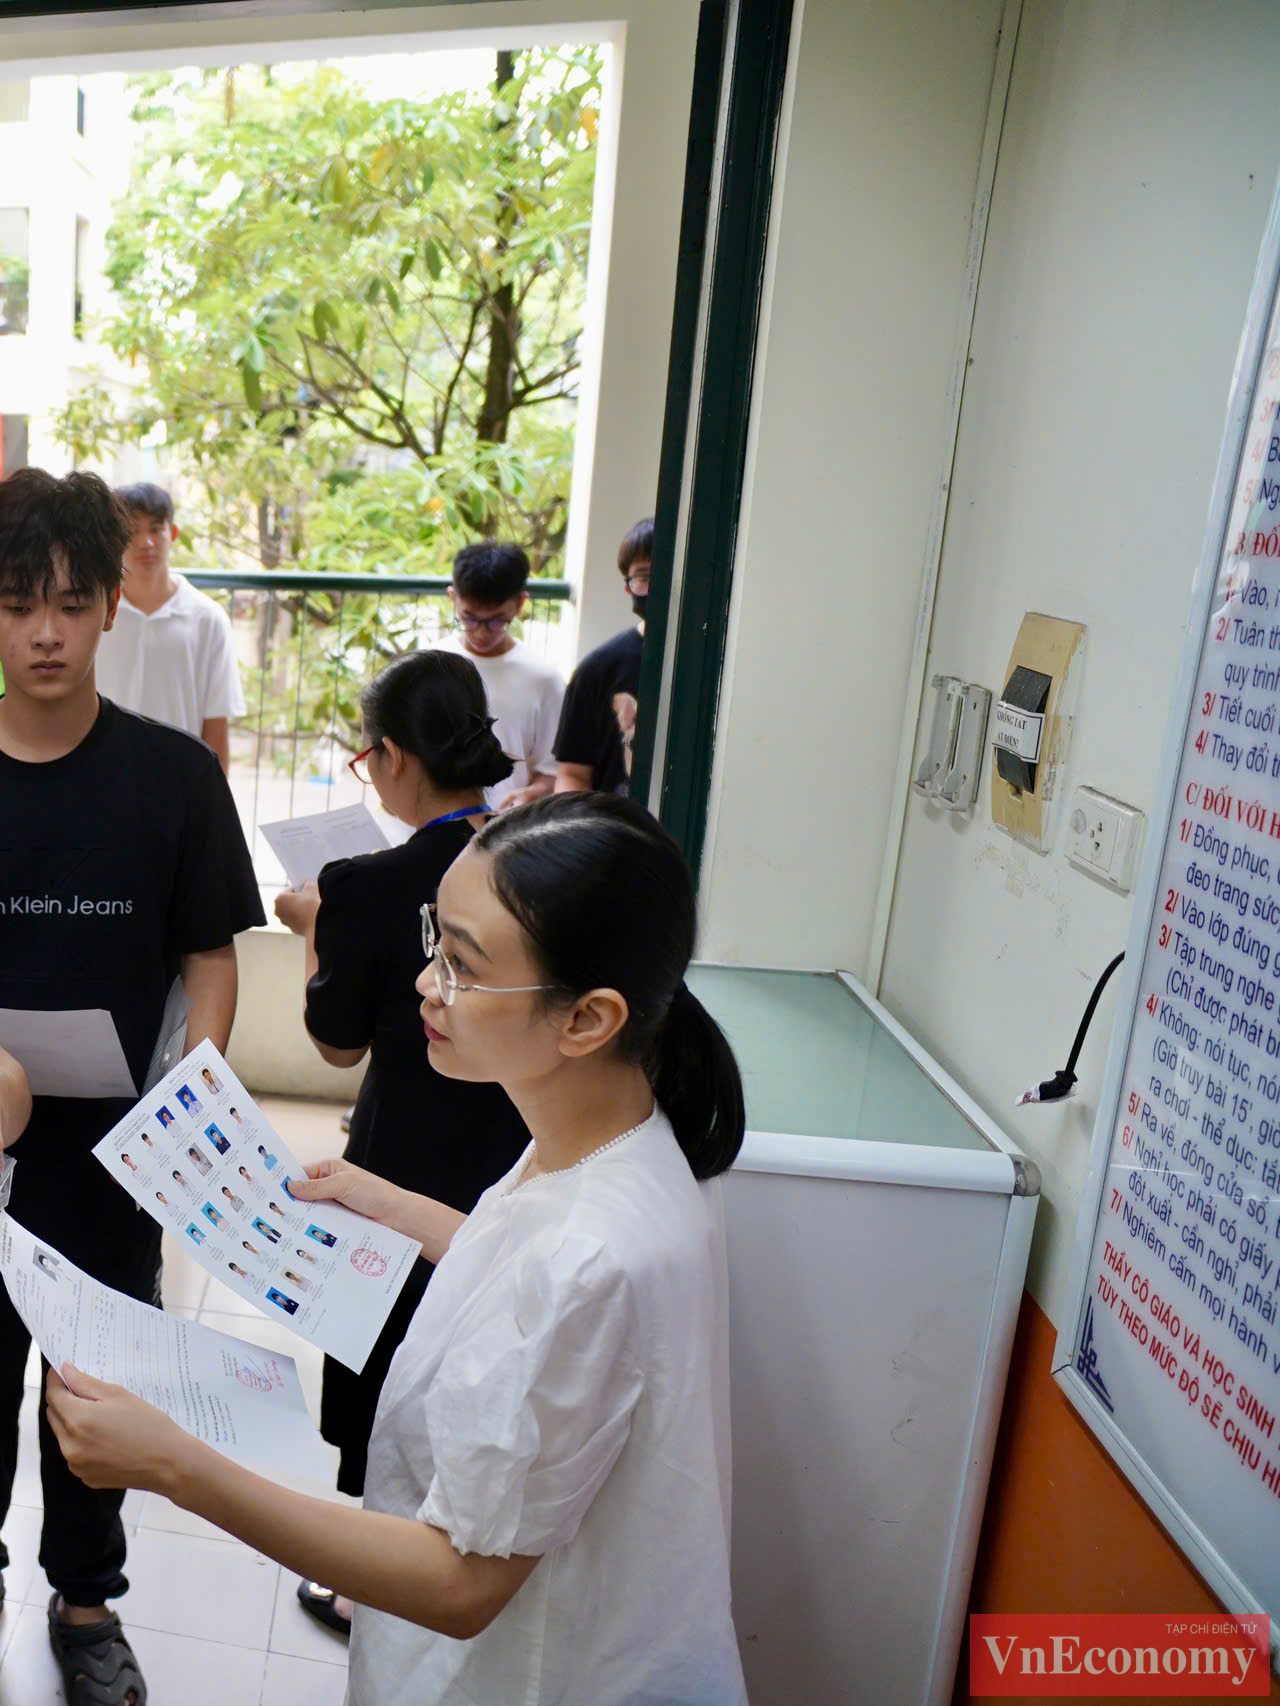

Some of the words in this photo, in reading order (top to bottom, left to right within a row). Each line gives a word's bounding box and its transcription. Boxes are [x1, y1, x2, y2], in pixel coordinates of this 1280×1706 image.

[1216, 617, 1231, 641] 2/
[1233, 618, 1265, 647] Tuân
[1241, 579, 1269, 610] Vào,
[1202, 691, 1217, 717] 3/
[1219, 695, 1242, 724] Tiết
[1245, 703, 1276, 733] cuối
[1224, 663, 1250, 691] quy
[1194, 729, 1209, 755] 4/
[1212, 733, 1243, 771] Thay
[1246, 742, 1270, 773] đổi
[1186, 782, 1203, 807] C/
[1202, 784, 1233, 819] ĐỐI
[1236, 799, 1267, 833] VỚI
[1180, 818, 1193, 844] 1/
[1193, 823, 1229, 866] Đồng
[1231, 843, 1271, 884] phục,
[1186, 861, 1211, 892] đeo
[1213, 873, 1250, 917] trang
[10, 894, 62, 914] Klein
[67, 895, 133, 915] Jeans
[1165, 889, 1180, 914] 2/
[1181, 895, 1206, 929] Vào
[1208, 910, 1230, 947] lớp
[1232, 926, 1271, 970] đúng
[1159, 924, 1173, 949] 3/
[1174, 930, 1197, 968] Tập
[1199, 948, 1234, 993] trung
[1237, 974, 1275, 1011] nghe
[1166, 966, 1195, 1003] (Chỉ
[1194, 986, 1227, 1025] được
[1229, 1011, 1263, 1048] phát
[1146, 992, 1160, 1018] 4/
[1159, 1000, 1203, 1052] Không:
[1204, 1038, 1227, 1065] nói
[1228, 1050, 1252, 1088] tục,
[1152, 1035, 1179, 1072] (Giờ
[1180, 1056, 1204, 1095] truy
[1206, 1074, 1228, 1109] bài
[1128, 1091, 1141, 1117] 5/
[1140, 1102, 1158, 1133] Ra
[1181, 1139, 1214, 1187] đóng
[1217, 1171, 1244, 1208] cửa
[1149, 1075, 1162, 1098] ra
[1164, 1088, 1191, 1121] chơi
[1201, 1111, 1225, 1146] thể
[1226, 1134, 1258, 1174] dục:
[1122, 1125, 1135, 1150] 6/
[1134, 1136, 1163, 1177] Nghỉ
[1162, 1161, 1185, 1198] học
[1186, 1190, 1218, 1228] phải
[1219, 1219, 1237, 1244] có
[1239, 1237, 1273, 1280] giấy
[1110, 1188, 1123, 1215] 7/
[1122, 1201, 1166, 1262] Nghiêm
[1168, 1254, 1197, 1292] cấm
[1199, 1283, 1227, 1321] mọi
[1228, 1306, 1268, 1363] hành
[1128, 1171, 1146, 1203] đột
[1147, 1190, 1172, 1228] xuất
[1181, 1223, 1205, 1258] cần
[1207, 1249, 1239, 1296] nghỉ,
[1242, 1282, 1278, 1326] phải
[1103, 1240, 1132, 1284] THẦY
[1131, 1273, 1149, 1304] CÔ
[1150, 1293, 1181, 1338] GIÁO
[1183, 1326, 1201, 1362] VÀ
[1201, 1349, 1235, 1396] HỌC
[1236, 1385, 1276, 1439] SINH
[1118, 1299, 1149, 1346] THEO
[1148, 1333, 1178, 1380] MỨC
[1178, 1367, 1200, 1407] ĐỘ
[1201, 1393, 1223, 1430] SẼ
[1223, 1418, 1261, 1471] CHỊU
